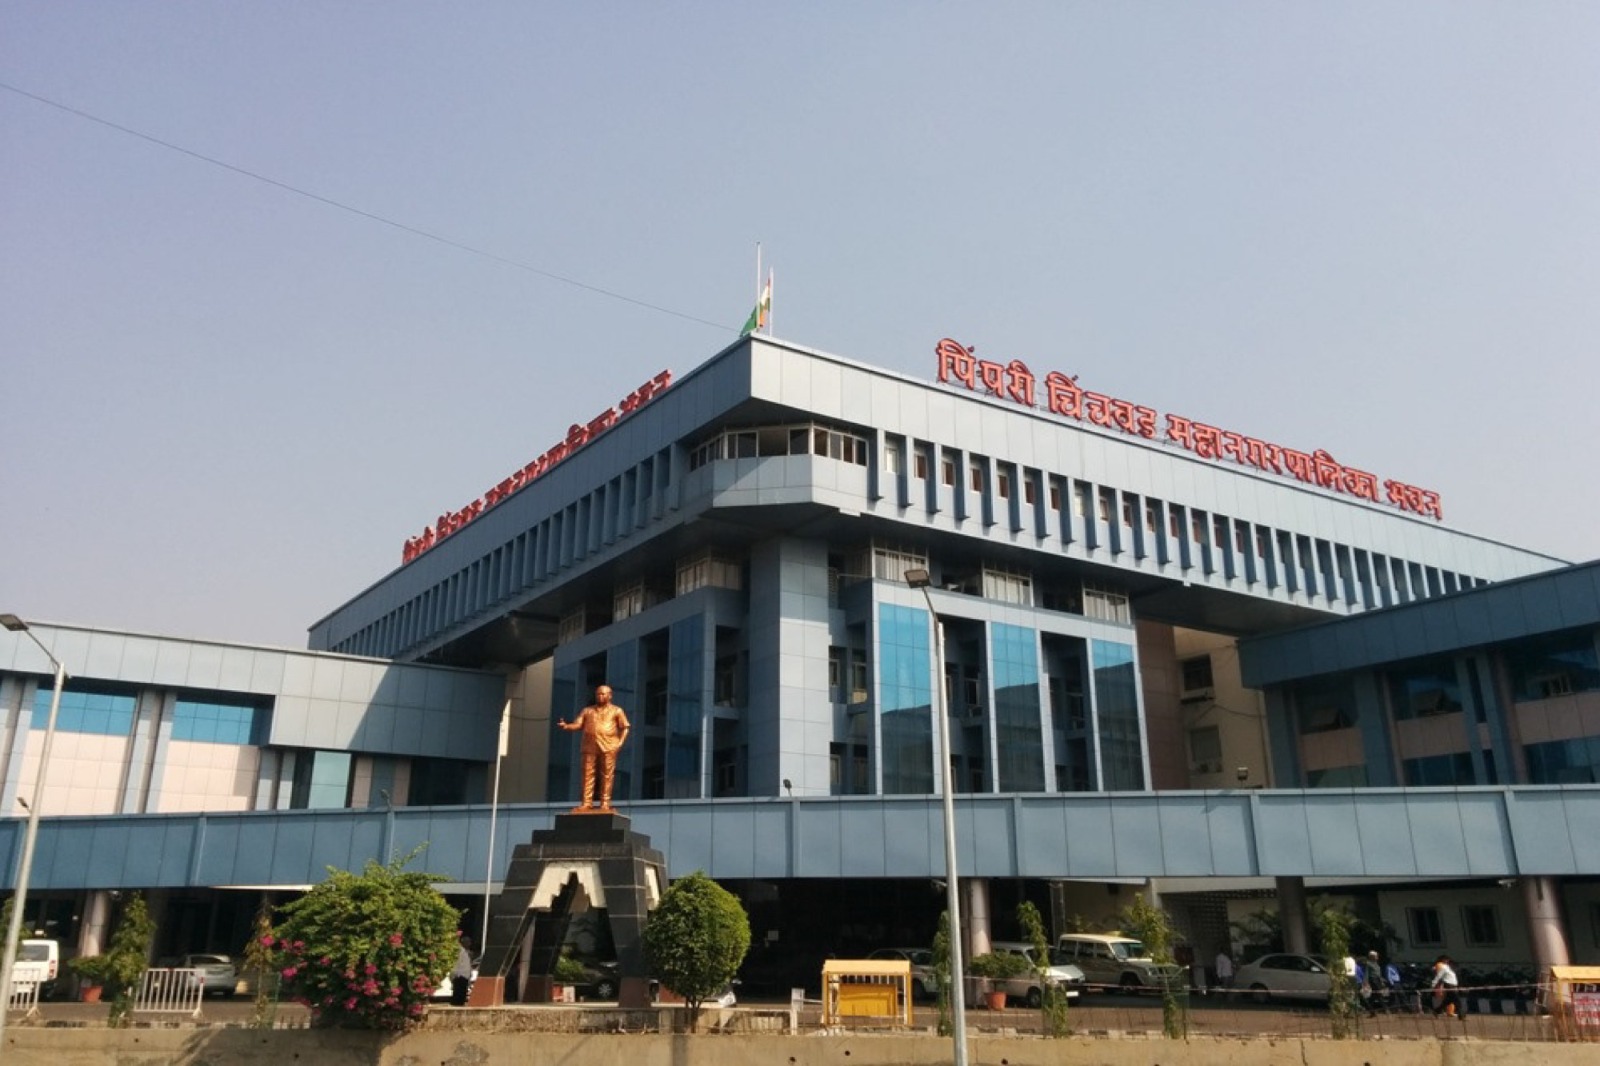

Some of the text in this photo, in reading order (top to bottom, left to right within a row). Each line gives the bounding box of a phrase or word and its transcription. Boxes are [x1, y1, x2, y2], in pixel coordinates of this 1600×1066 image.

[936, 337, 1443, 521] पिंपरी चिंचवड महानगरपालिका भवन
